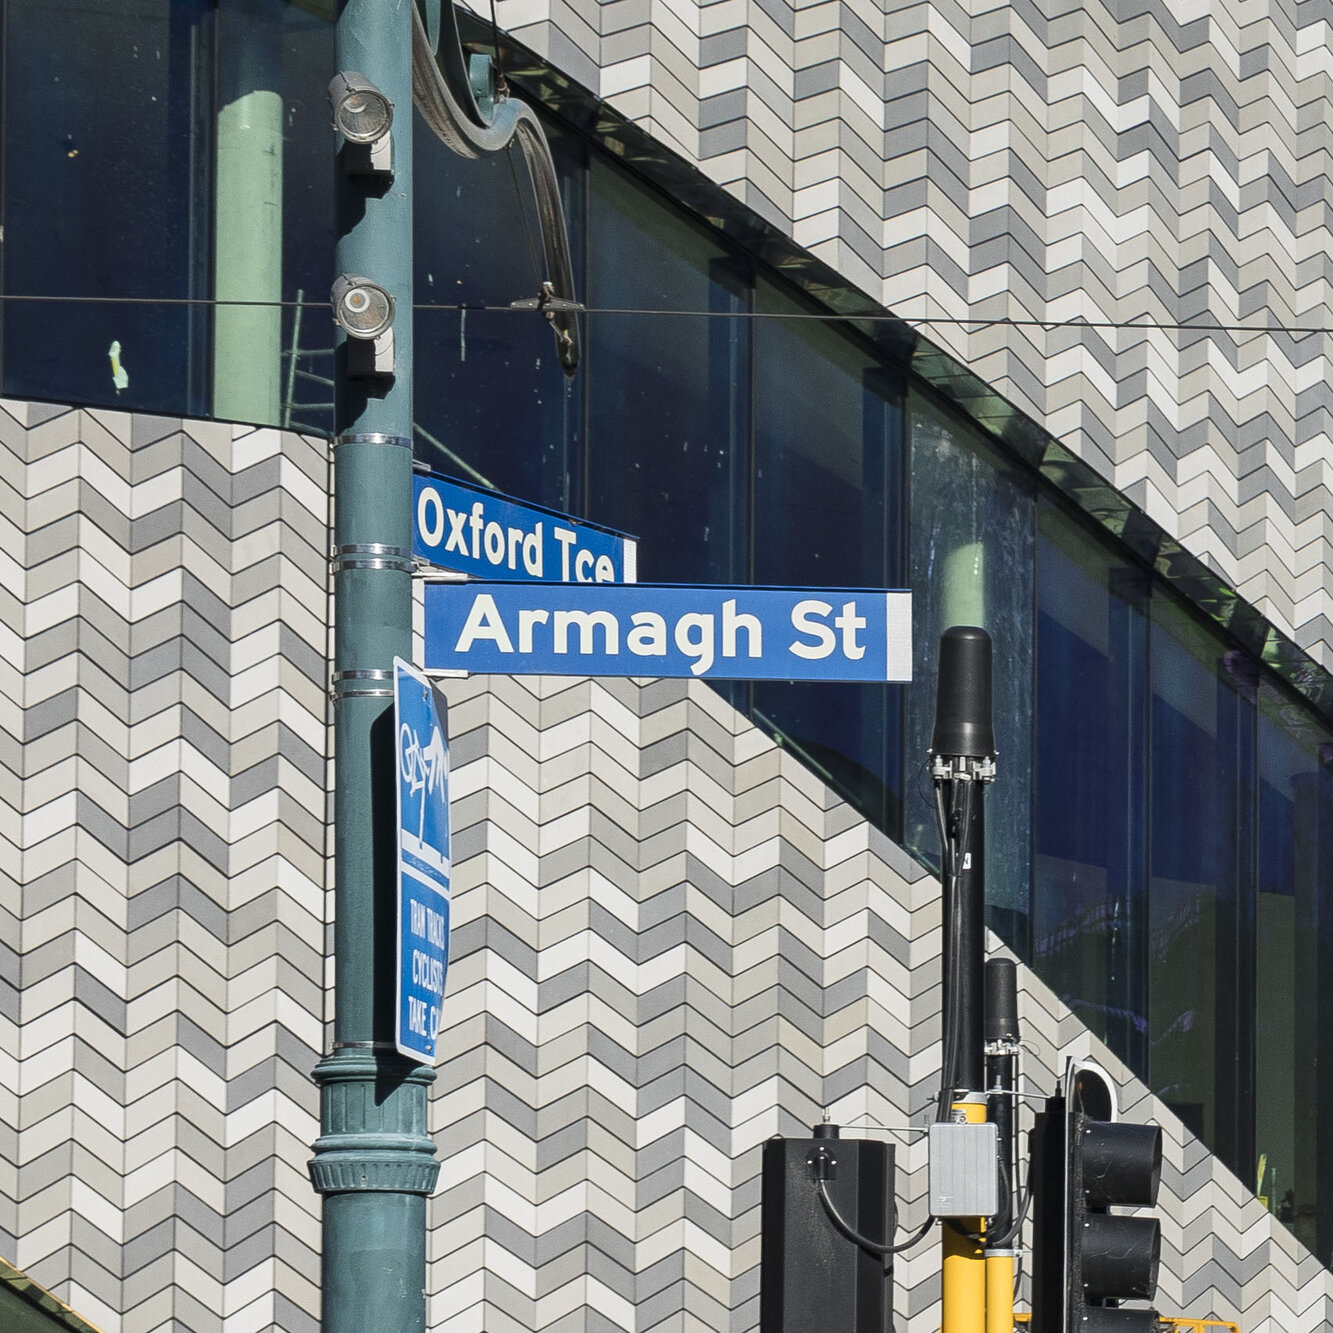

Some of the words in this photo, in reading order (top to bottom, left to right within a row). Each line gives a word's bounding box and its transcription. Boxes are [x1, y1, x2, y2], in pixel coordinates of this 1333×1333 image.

[417, 486, 544, 578] Oxford
[554, 526, 615, 583] Tce
[454, 593, 763, 676] Armagh
[788, 599, 867, 660] St
[408, 996, 428, 1036] TAKE
